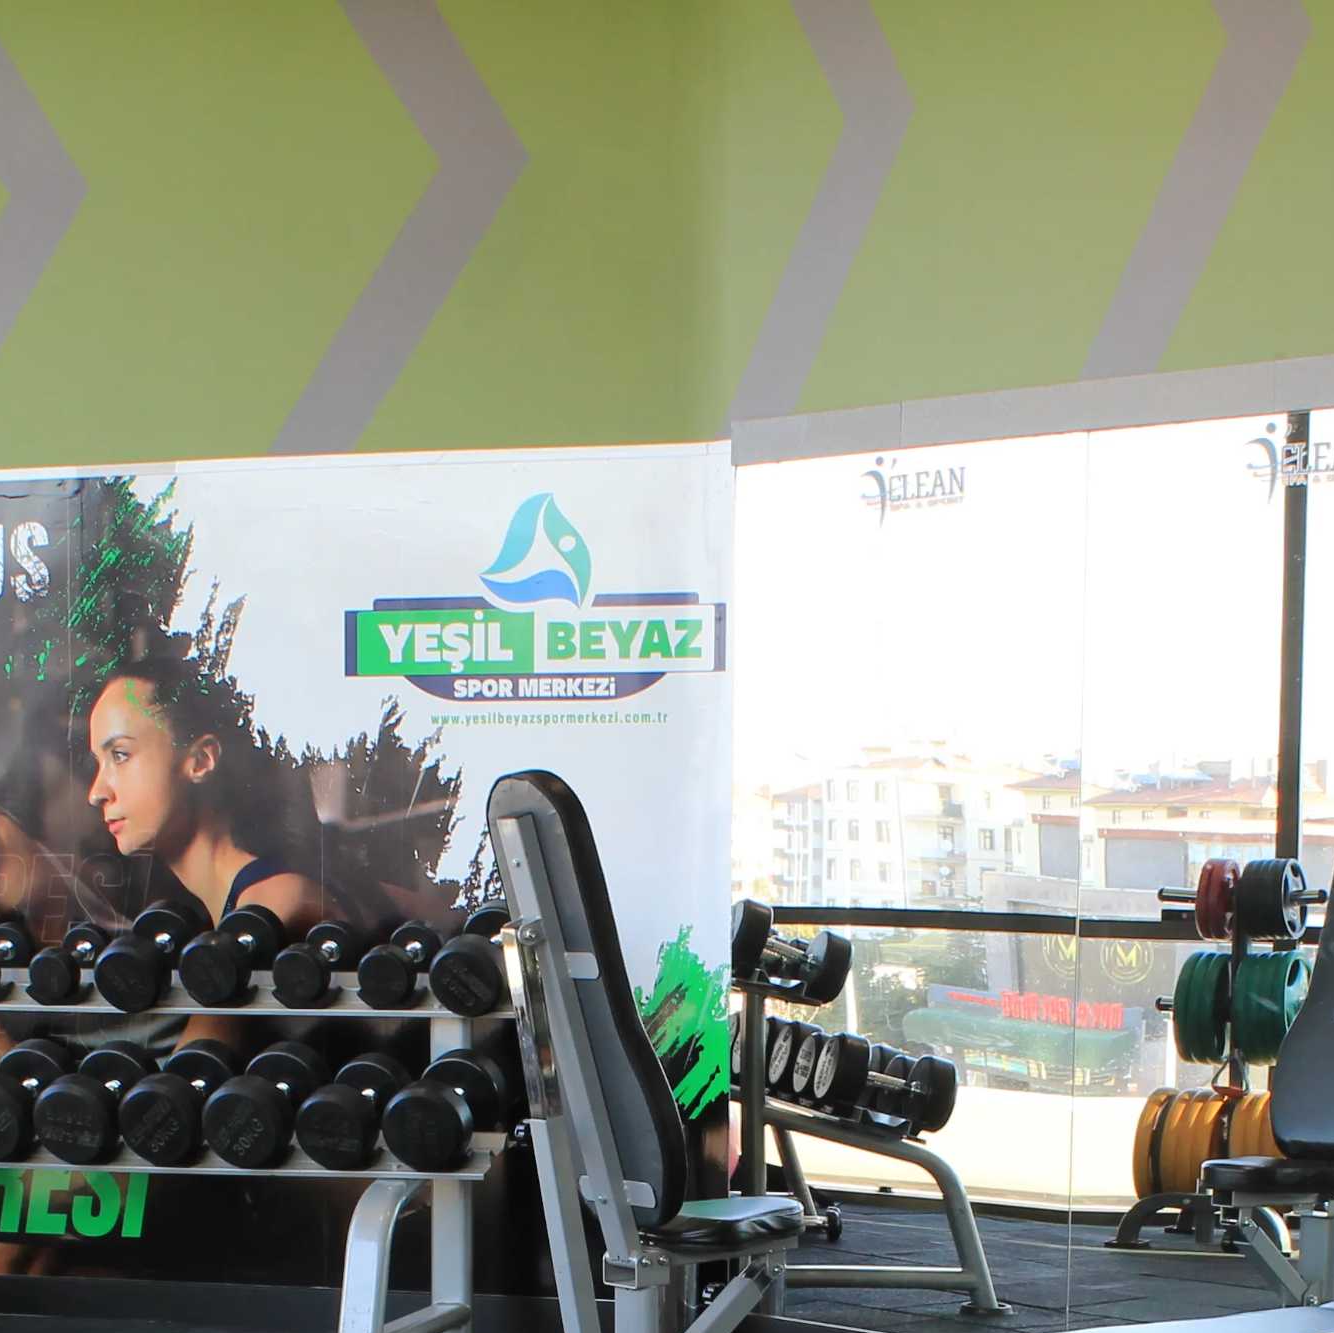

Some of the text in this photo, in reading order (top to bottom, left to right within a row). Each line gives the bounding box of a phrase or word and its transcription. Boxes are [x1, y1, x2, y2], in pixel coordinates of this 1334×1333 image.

[377, 610, 704, 672] YEŞİL BEYAZ
[453, 678, 514, 698] SPOR
[430, 711, 668, 726] www.yesilbeyazspormerkezi.com.tr
